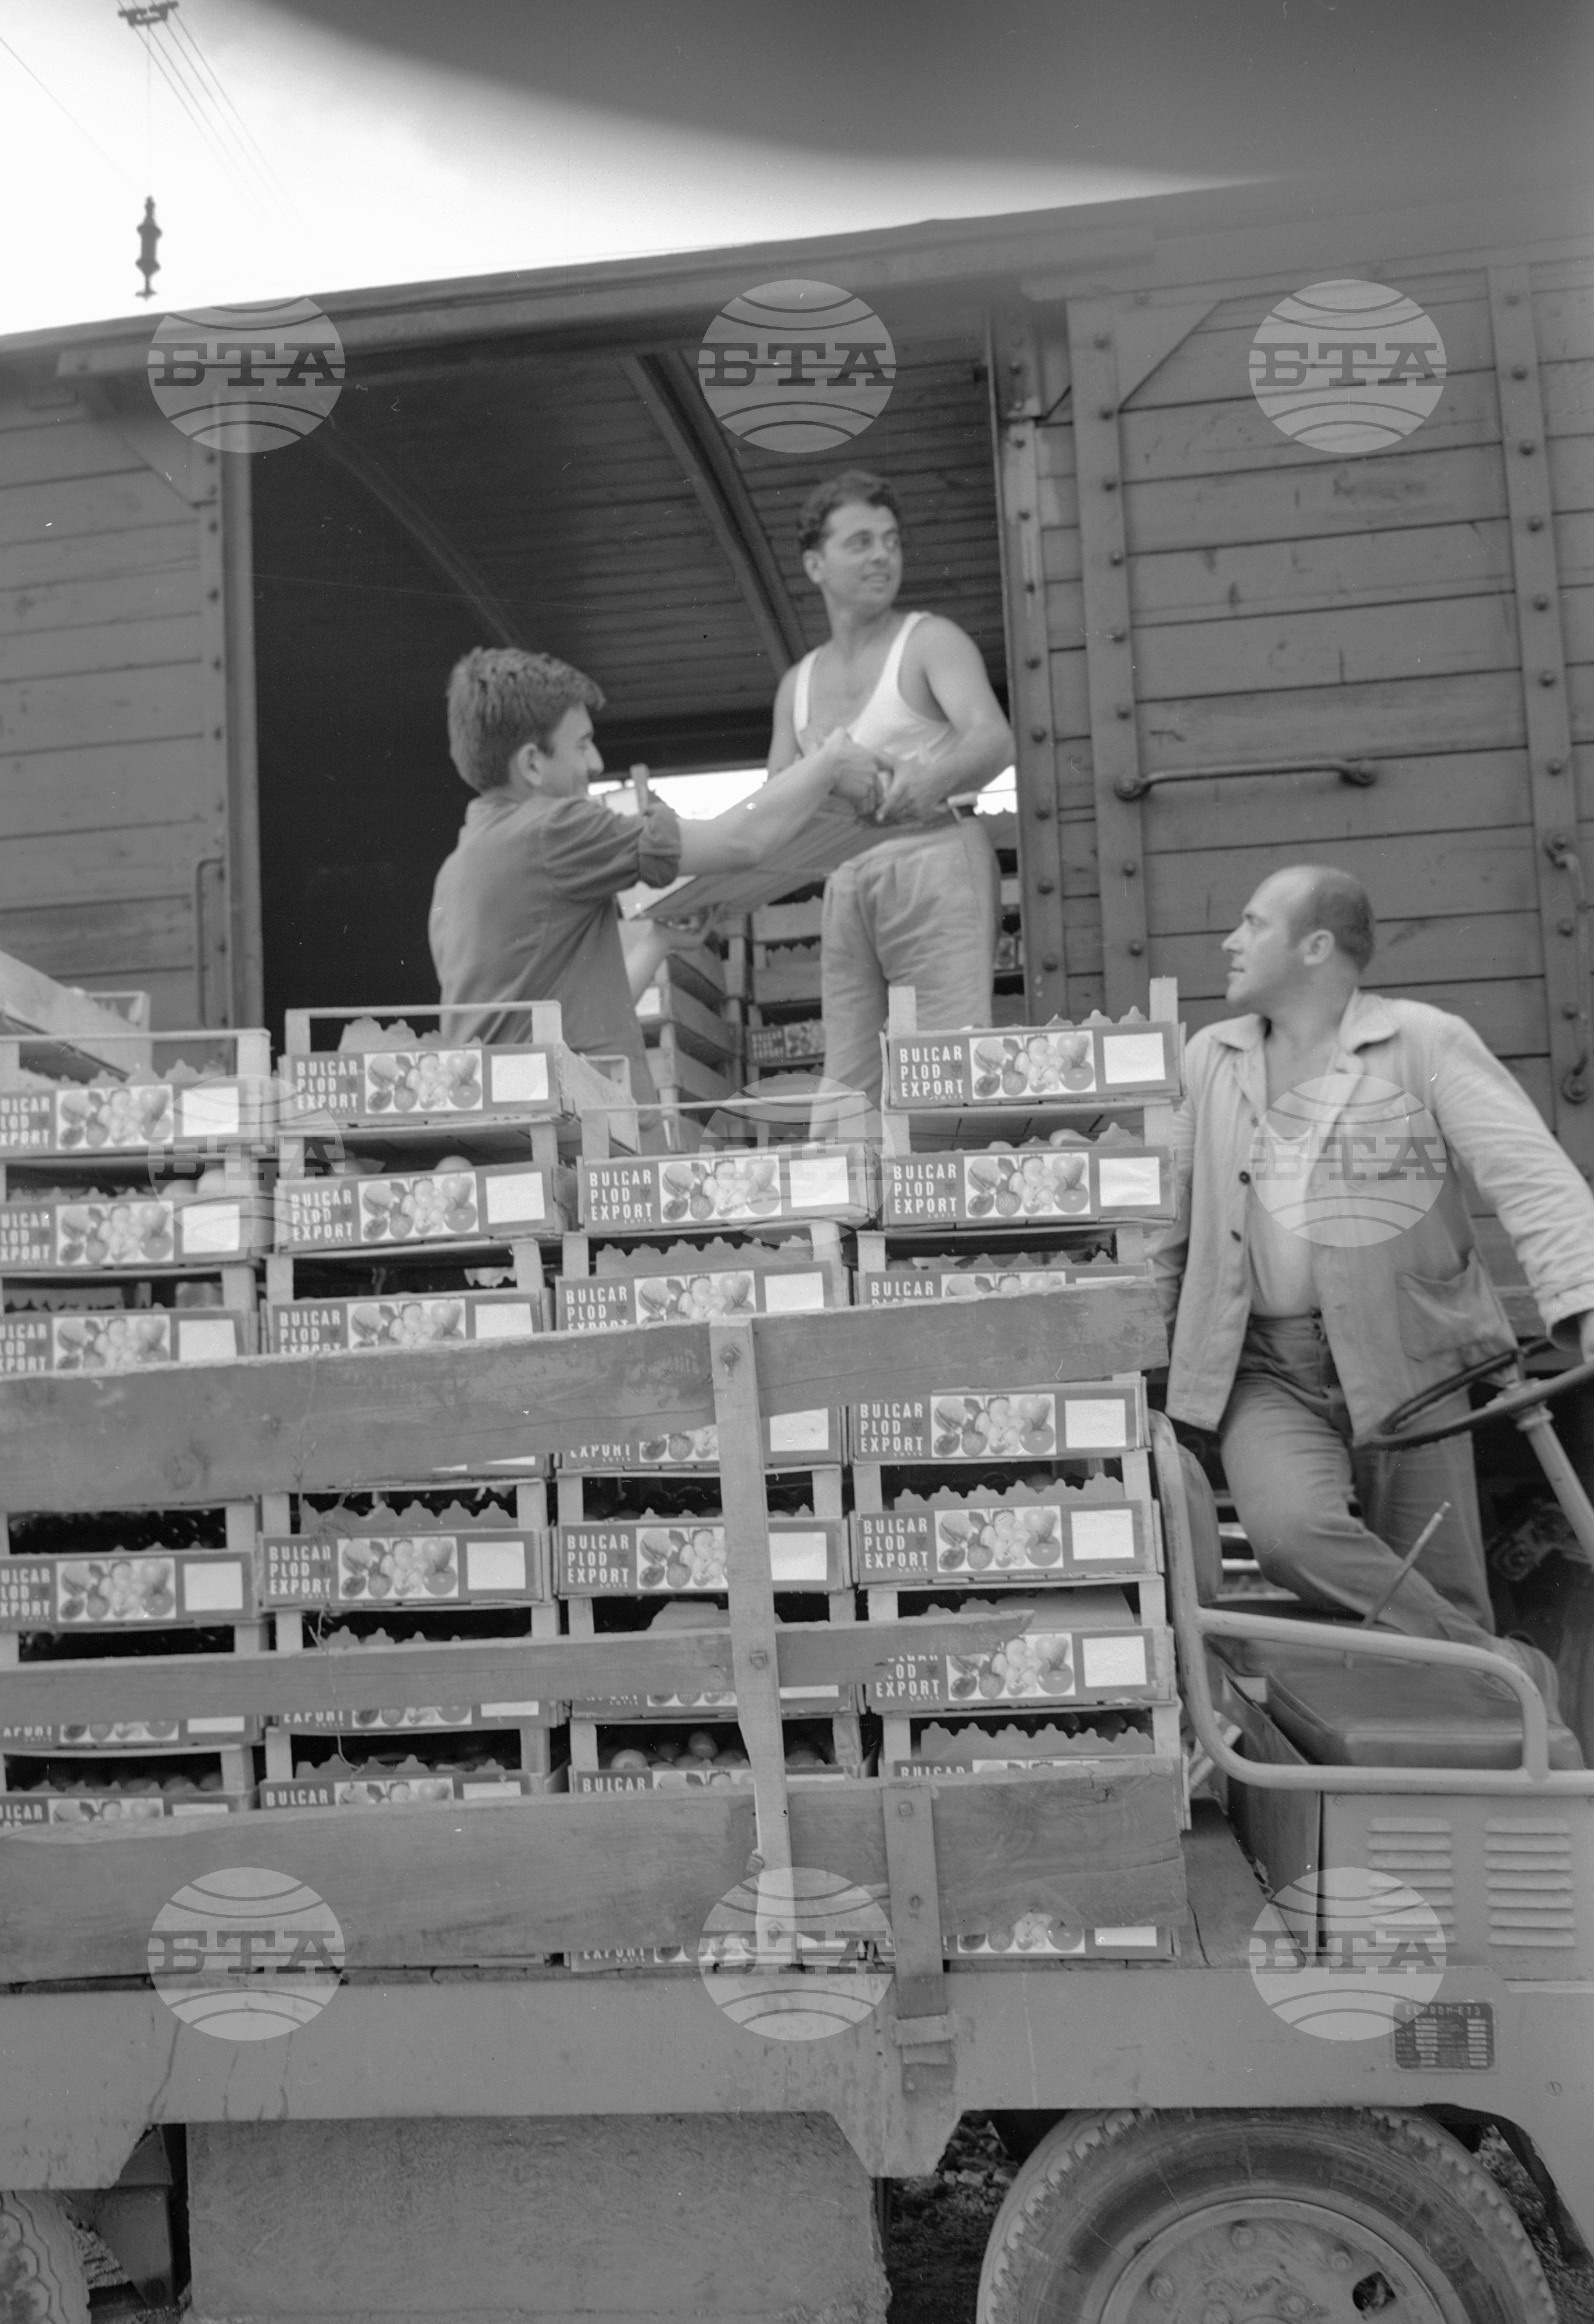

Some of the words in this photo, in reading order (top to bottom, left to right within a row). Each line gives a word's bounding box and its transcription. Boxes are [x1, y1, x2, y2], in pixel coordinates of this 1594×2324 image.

[900, 1063, 940, 1080] PLOD
[297, 1078, 337, 1093] PLOD
[902, 1079, 963, 1097] EXPORT
[297, 1093, 358, 1109] EXPORT
[591, 1188, 630, 1204] PLOD
[895, 1181, 934, 1197] PLOD
[591, 1202, 652, 1221] EXPORT
[895, 1197, 957, 1214] EXPORT
[292, 1208, 332, 1225] PLOD
[293, 1222, 353, 1242] EXPORT
[568, 1304, 606, 1321] PLOD
[280, 1327, 320, 1343] PLOD
[861, 1420, 900, 1436] PLOD
[860, 1436, 923, 1452] EXPORT
[864, 1535, 906, 1552] PLOD
[568, 1551, 607, 1567] PLOD
[865, 1551, 928, 1569] EXPORT
[270, 1562, 310, 1578] PLOD
[568, 1568, 629, 1584] EXPORT
[270, 1578, 331, 1595] EXPORT
[875, 1680, 939, 1697] EXPORT
